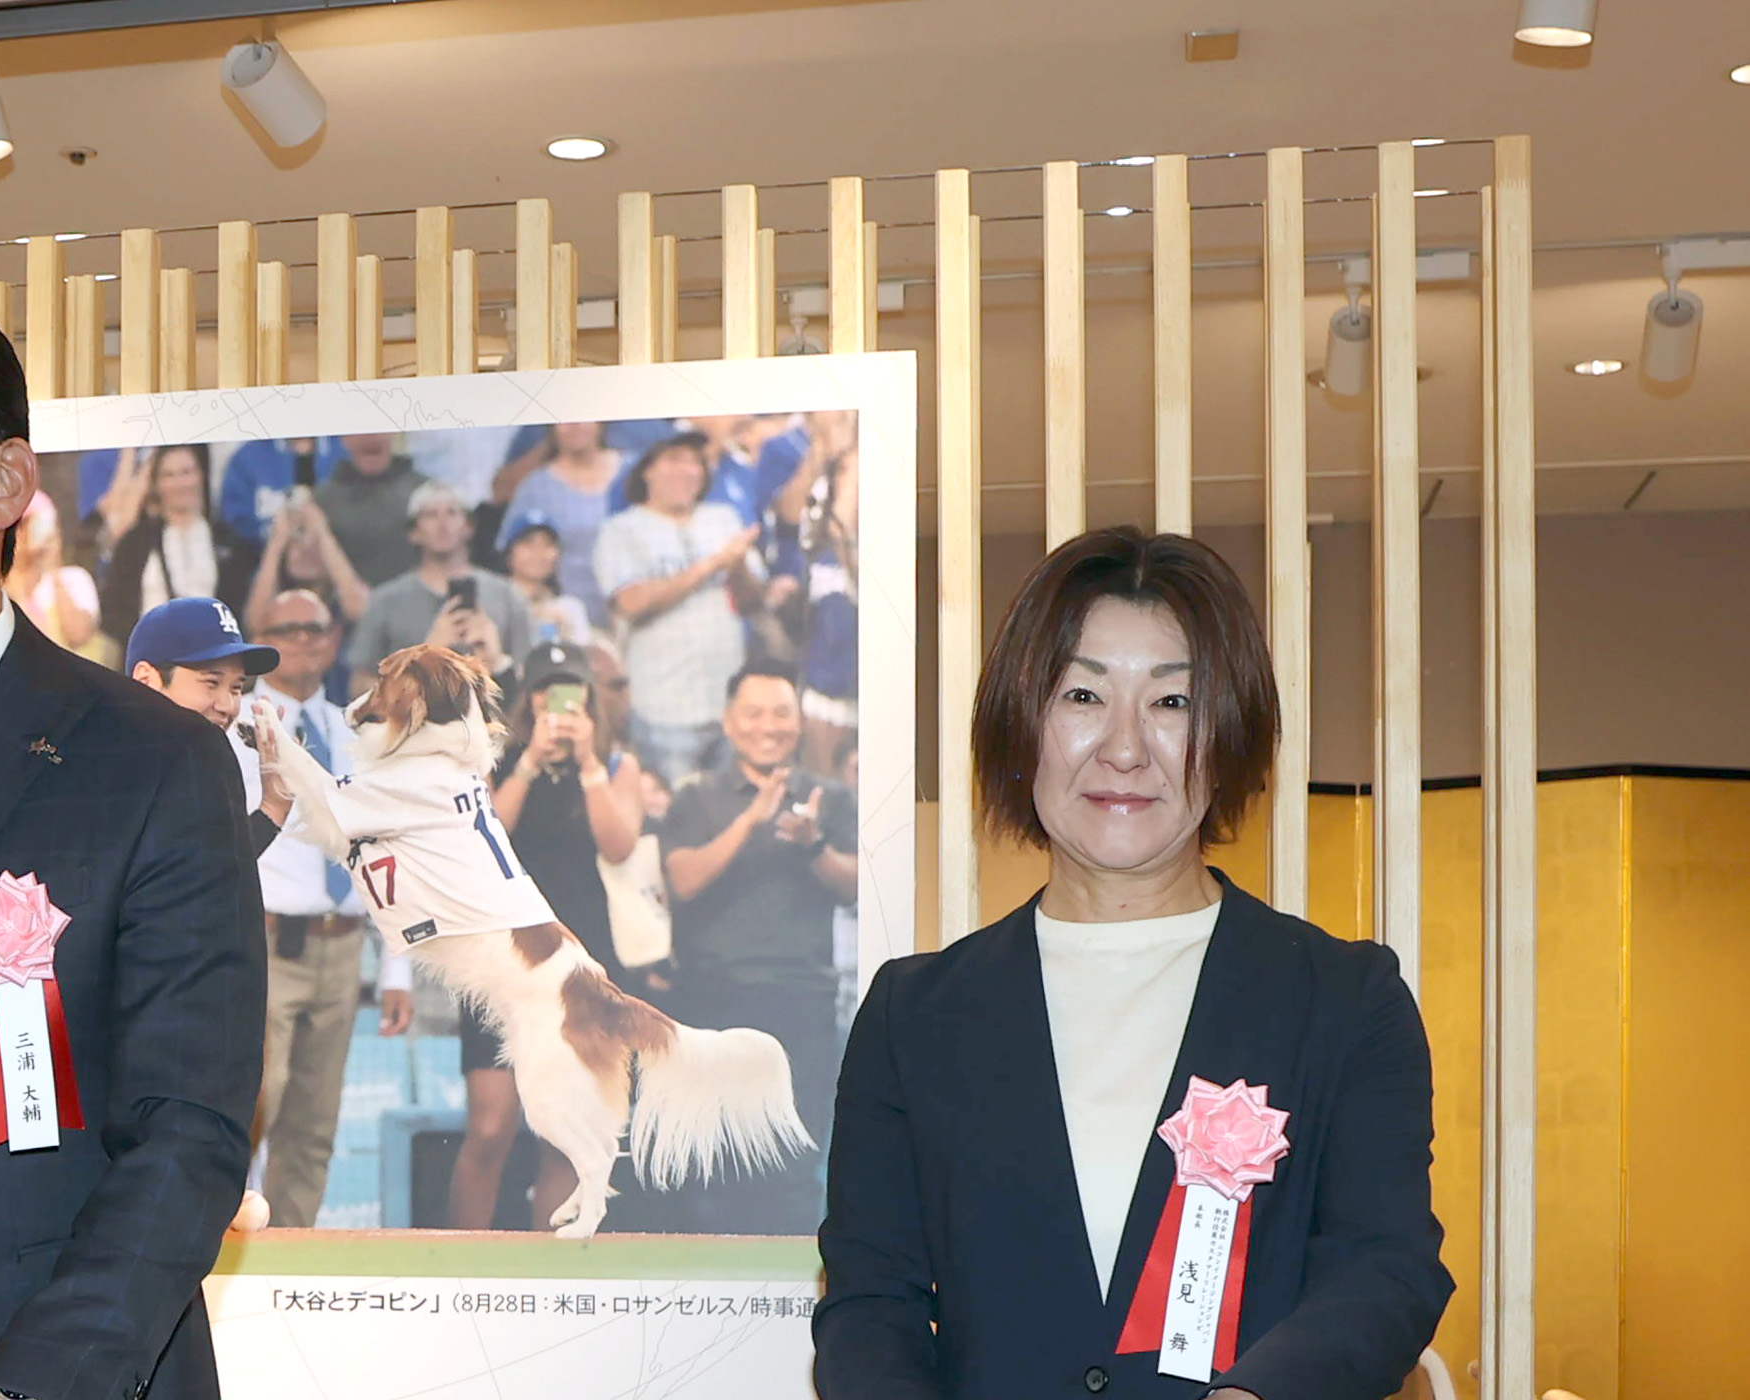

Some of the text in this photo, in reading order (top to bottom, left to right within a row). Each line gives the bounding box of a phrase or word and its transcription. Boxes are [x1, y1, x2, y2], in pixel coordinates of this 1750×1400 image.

[362, 855, 397, 909] 17
[15, 1032, 35, 1071] 三浦
[1177, 1260, 1199, 1304] 浅見
